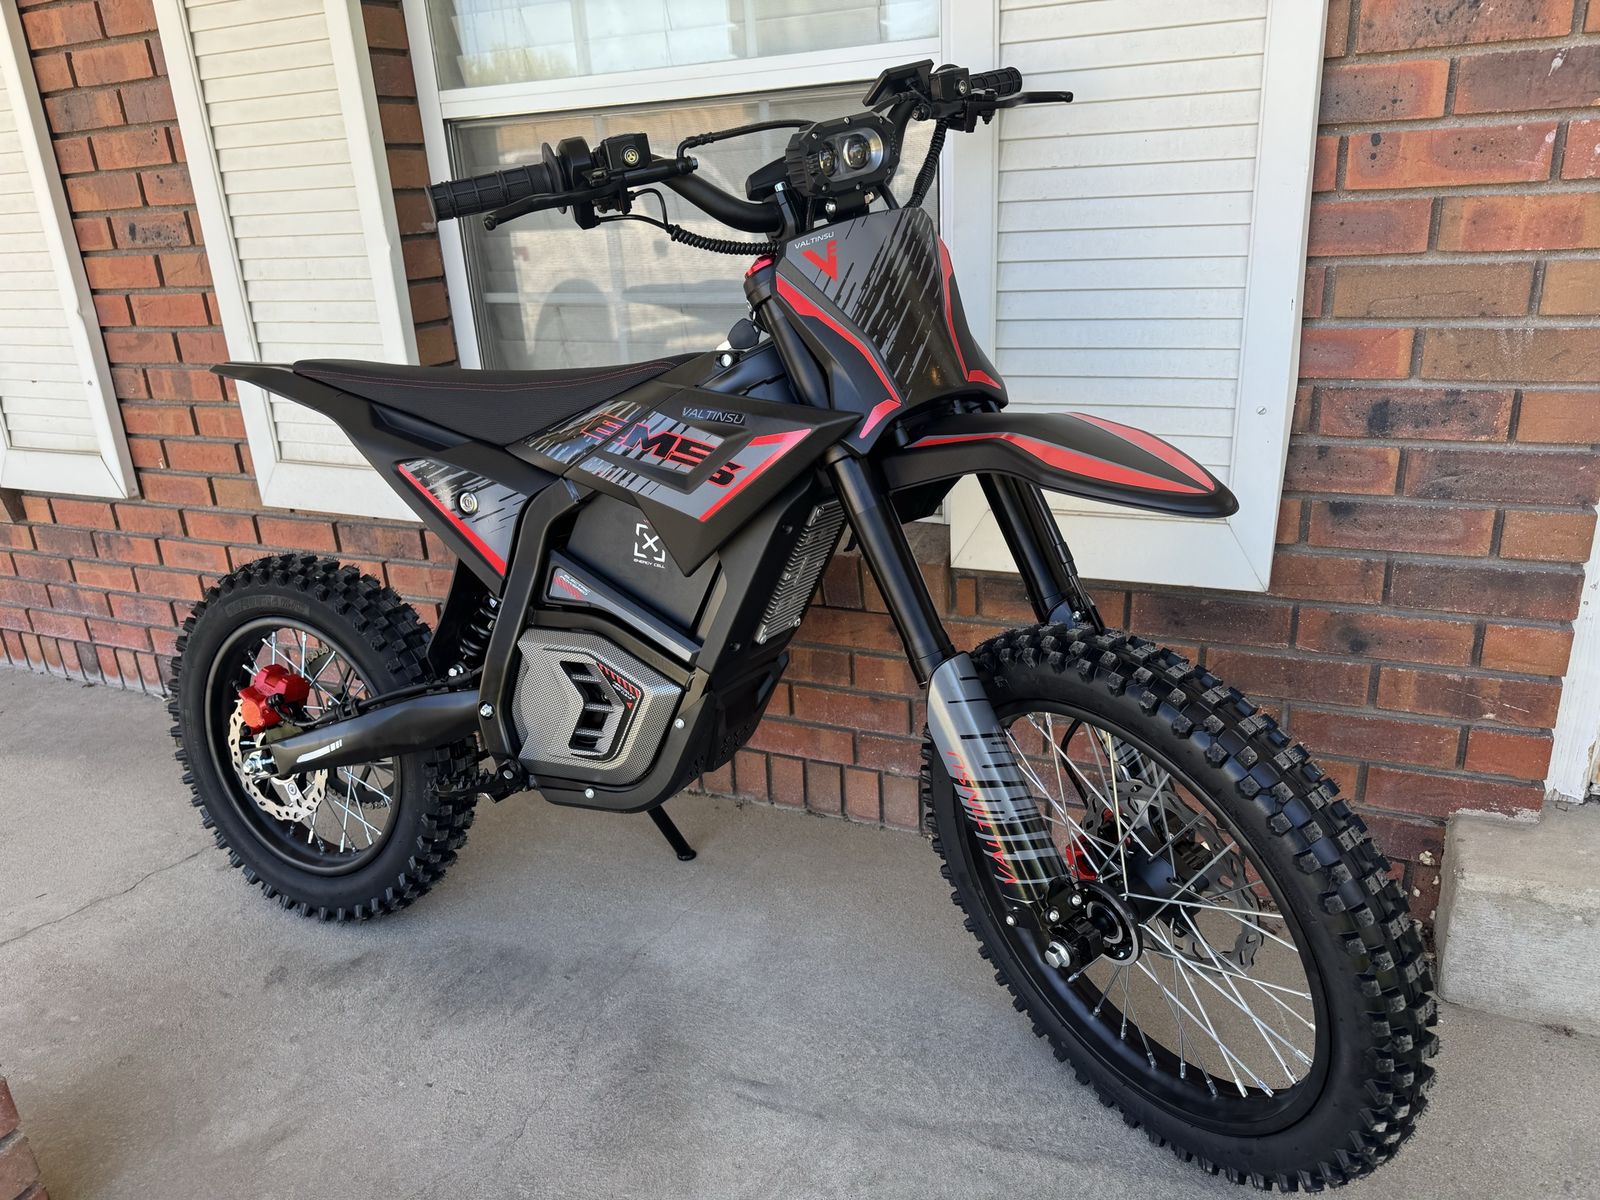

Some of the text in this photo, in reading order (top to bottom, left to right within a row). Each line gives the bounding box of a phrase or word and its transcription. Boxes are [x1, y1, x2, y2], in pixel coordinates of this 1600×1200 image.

[794, 231, 835, 249] VALTINSU
[681, 407, 745, 424] VALTINSU
[947, 752, 1019, 884] VALTINSU
